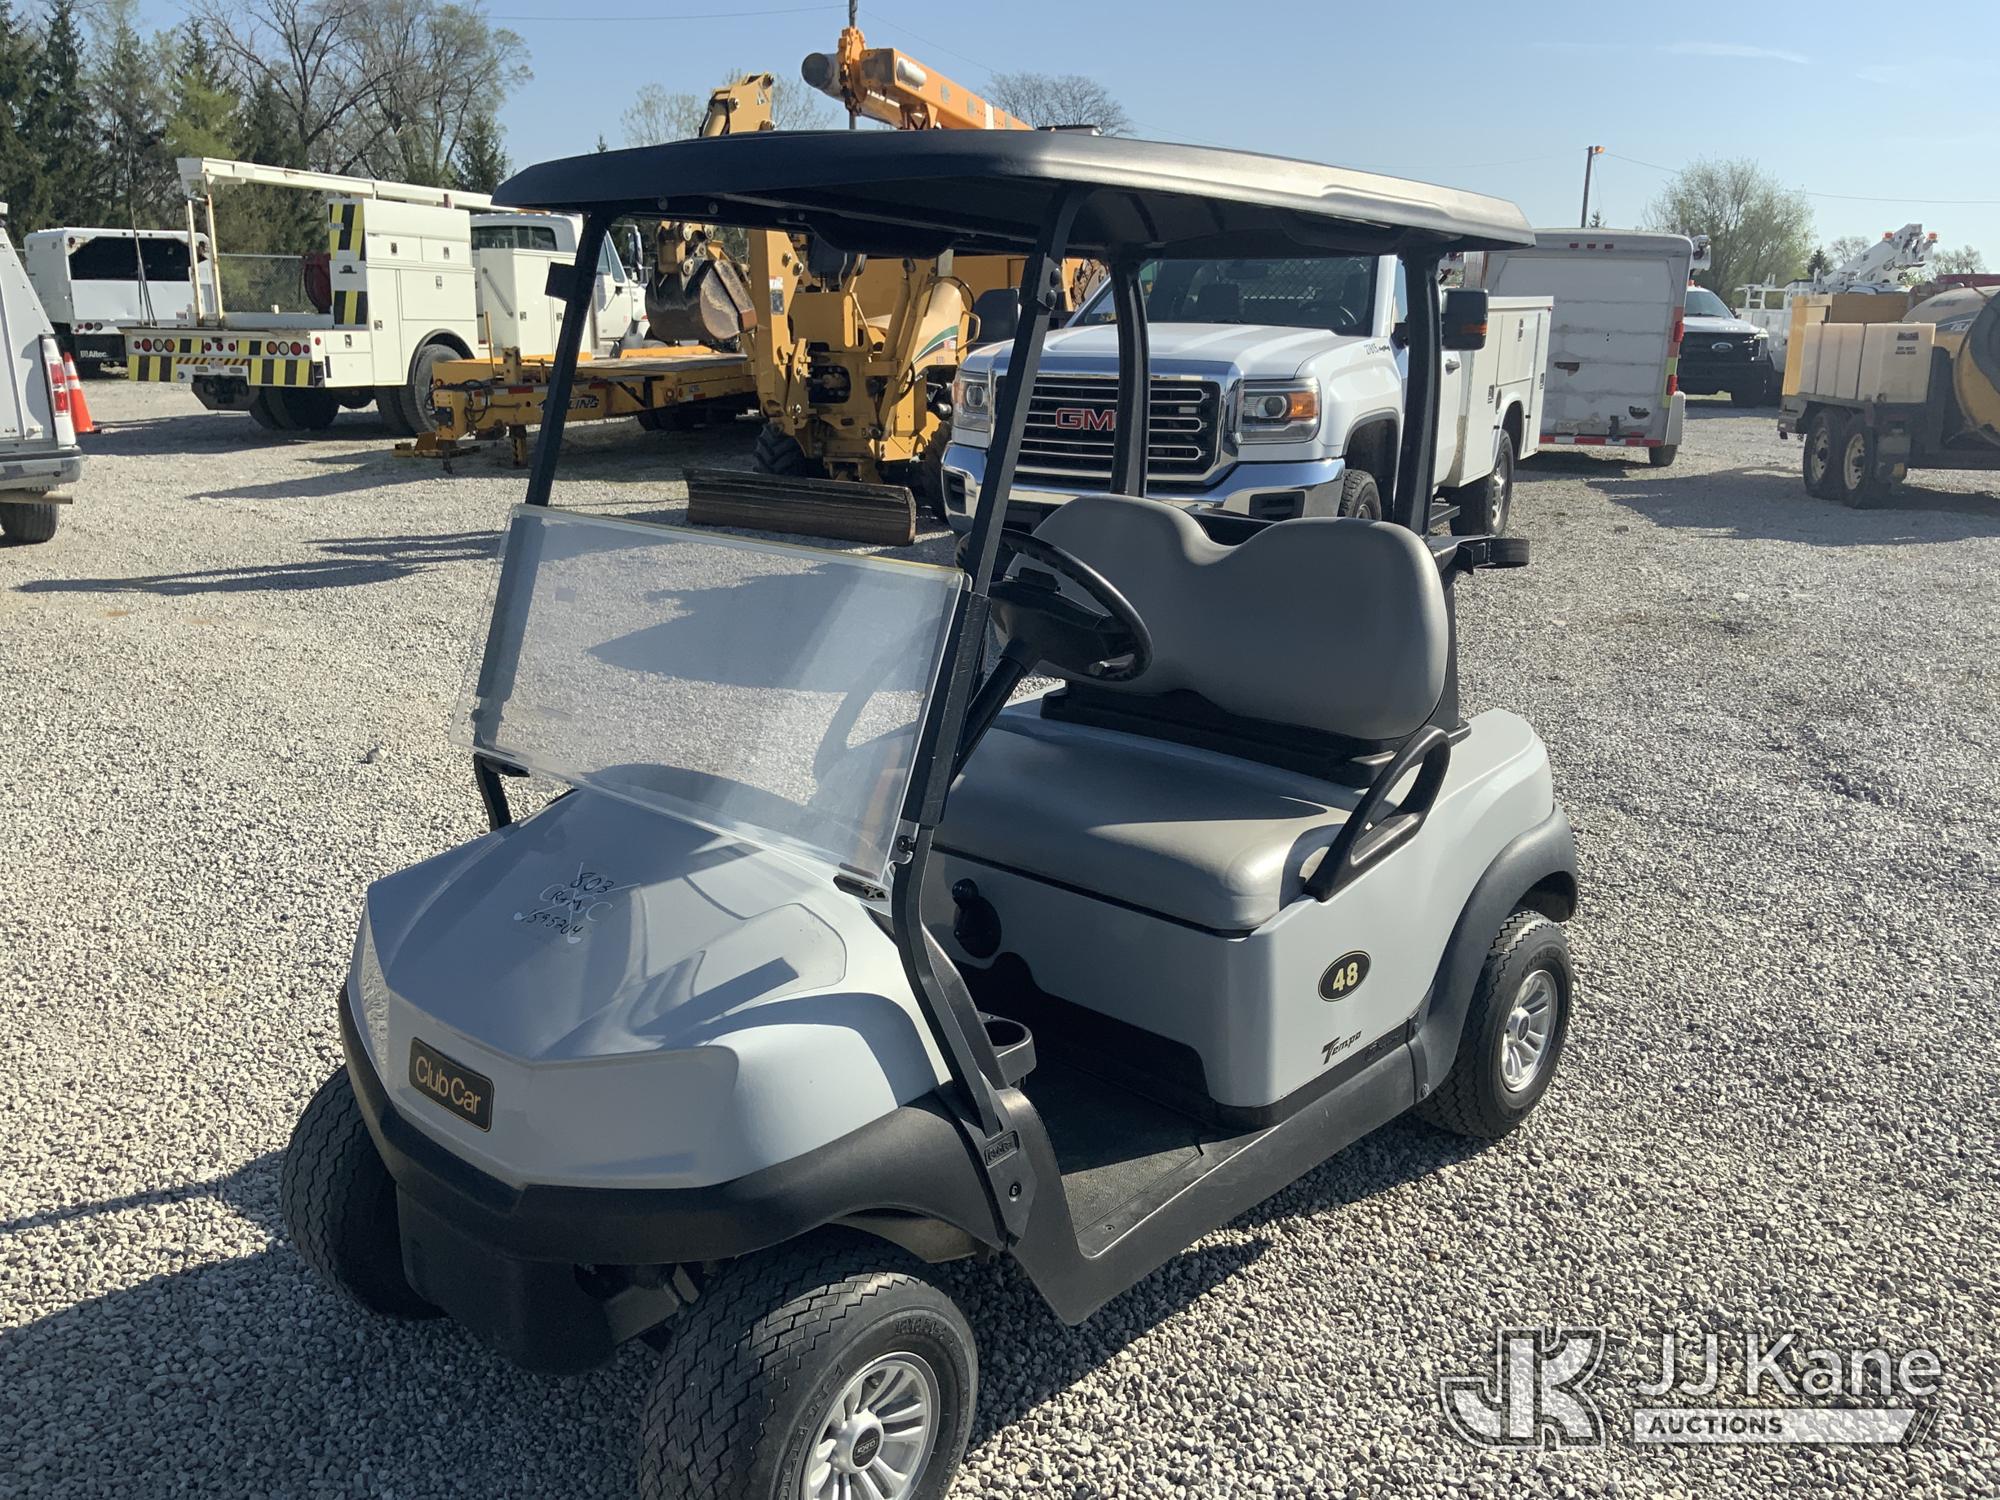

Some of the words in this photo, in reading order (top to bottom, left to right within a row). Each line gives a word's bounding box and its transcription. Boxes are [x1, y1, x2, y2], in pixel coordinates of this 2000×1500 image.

[1055, 407, 1116, 432] GM
[1332, 961, 1359, 992] 48
[1321, 1030, 1362, 1065] Tempo
[415, 1055, 449, 1097] Club
[450, 1077, 481, 1114] Car
